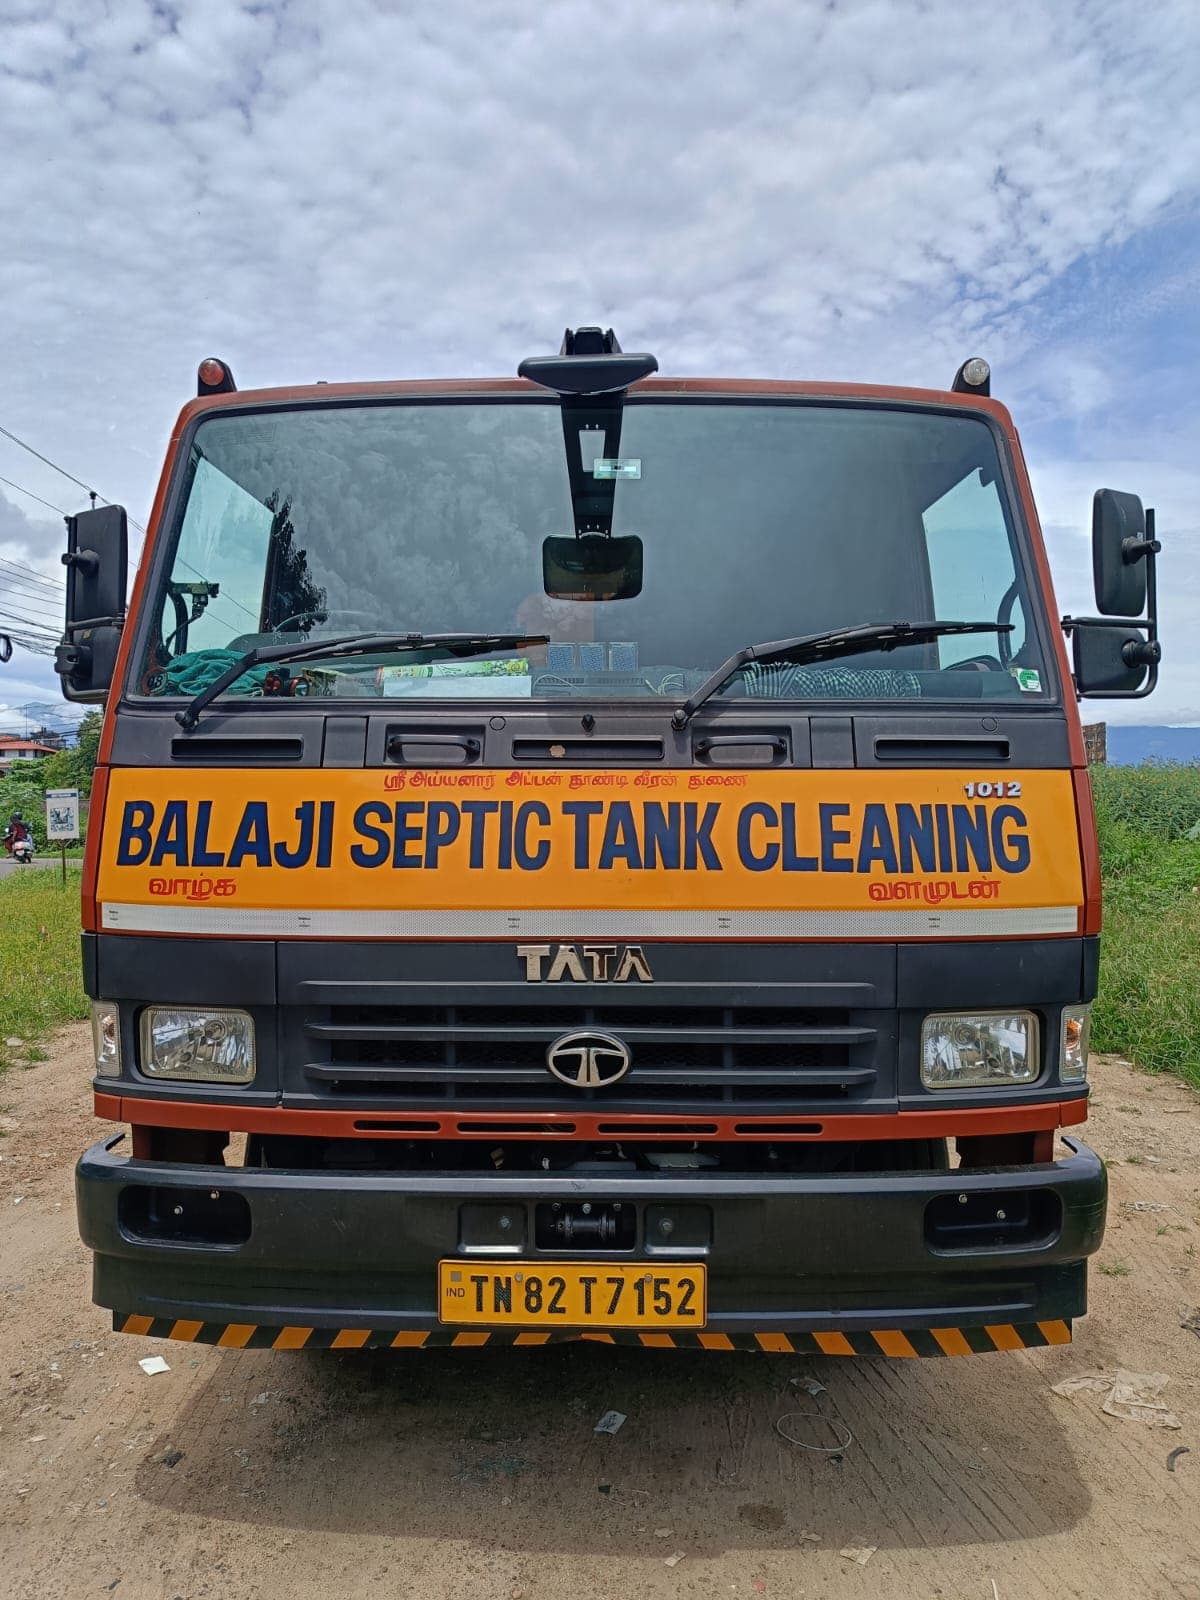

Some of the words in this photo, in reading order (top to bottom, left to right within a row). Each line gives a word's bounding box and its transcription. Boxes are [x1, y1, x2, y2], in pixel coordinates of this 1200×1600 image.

[633, 770, 678, 789] வீரன்
[964, 781, 1022, 799] 1012
[116, 800, 336, 870] BALAJI
[350, 800, 552, 870] SEPTIC
[562, 800, 723, 870] TANK
[736, 802, 1031, 873] CLEANING
[149, 872, 237, 901] வாழ்க
[868, 876, 1001, 904] வளமுடன்
[516, 945, 654, 982] TATA
[446, 1287, 465, 1297] IND
